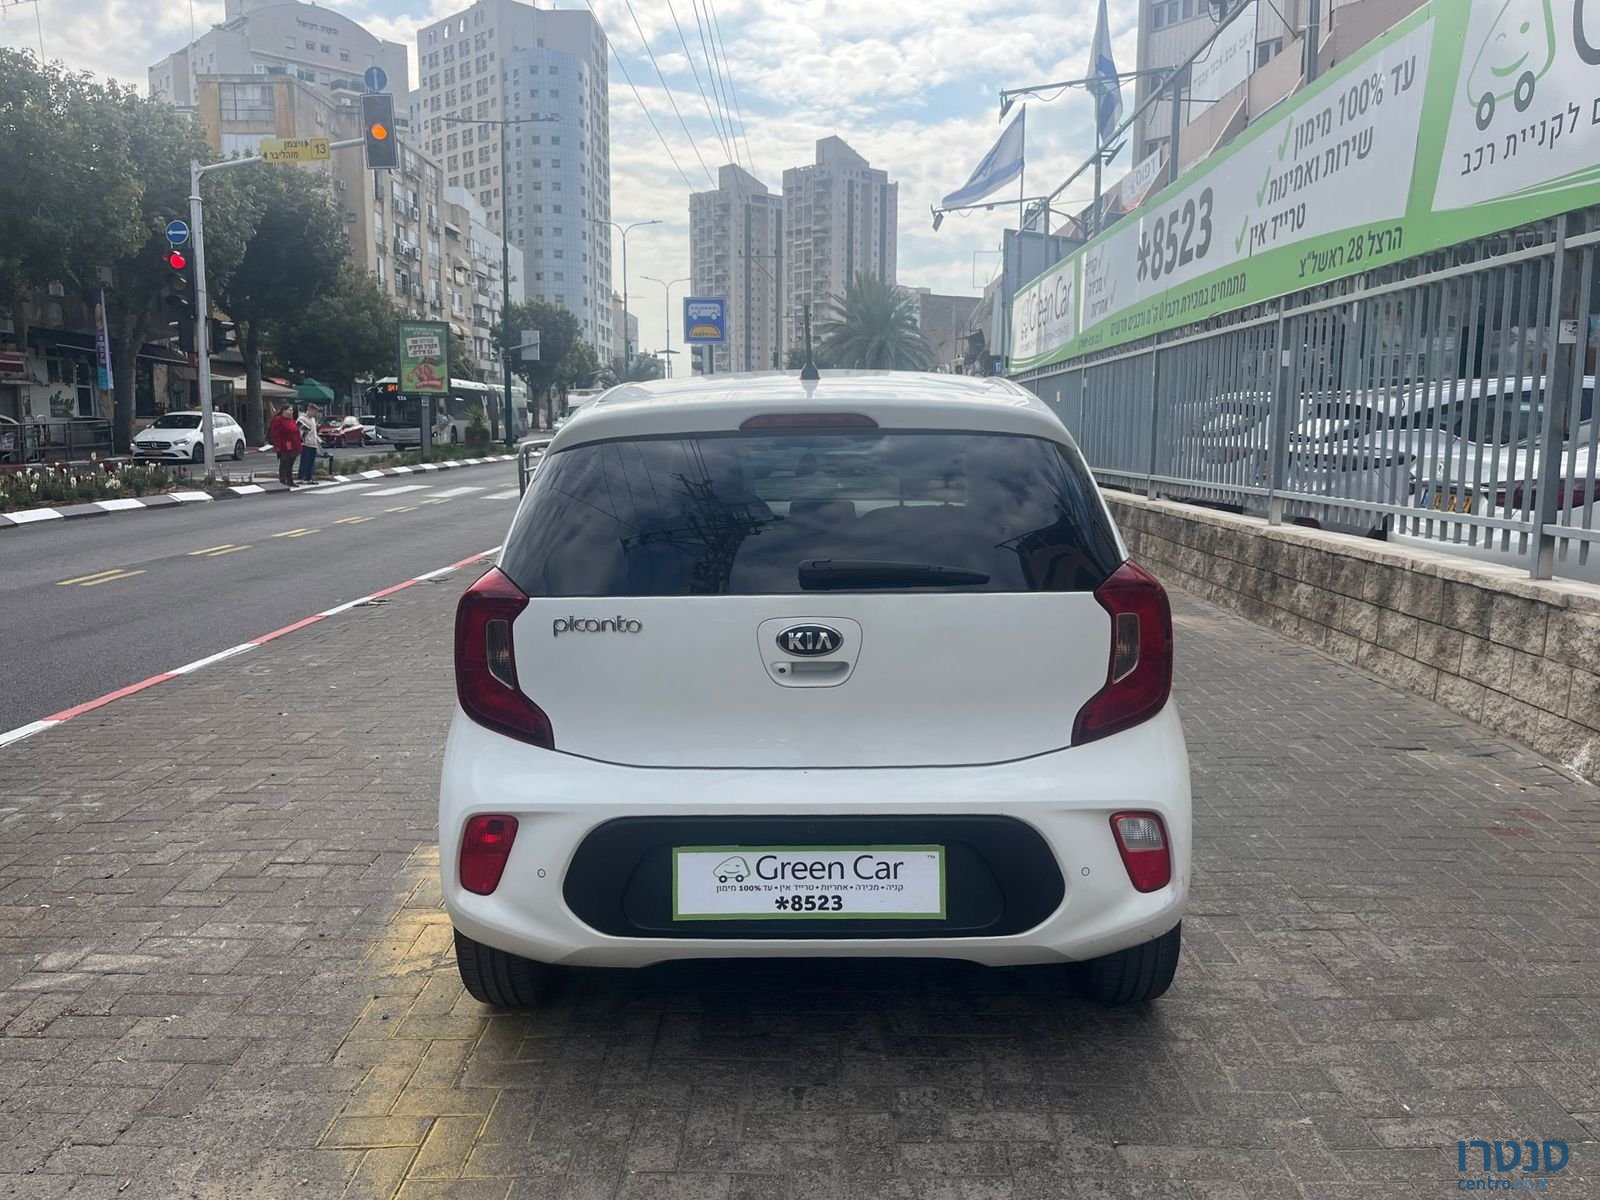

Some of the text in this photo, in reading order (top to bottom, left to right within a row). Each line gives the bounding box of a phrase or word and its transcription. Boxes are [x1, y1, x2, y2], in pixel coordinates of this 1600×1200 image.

[1293, 55, 1416, 161] עד 100% מימון
[1503, 102, 1580, 160] לקניית
[314, 143, 327, 154] 13
[1461, 142, 1495, 176] רכב
[1267, 126, 1374, 205] שירות ואמינות
[1249, 203, 1306, 257] טרייד אין
[1368, 227, 1403, 256] הרצל
[1347, 234, 1364, 263] 28
[1055, 275, 1072, 320] Car
[1211, 272, 1246, 304] מתמחים
[553, 615, 643, 637] picanto
[787, 631, 833, 650] KIA
[756, 855, 904, 881] Green Car
[716, 885, 737, 893] מימון
[780, 884, 791, 892] אין
[885, 884, 904, 892] קניה
